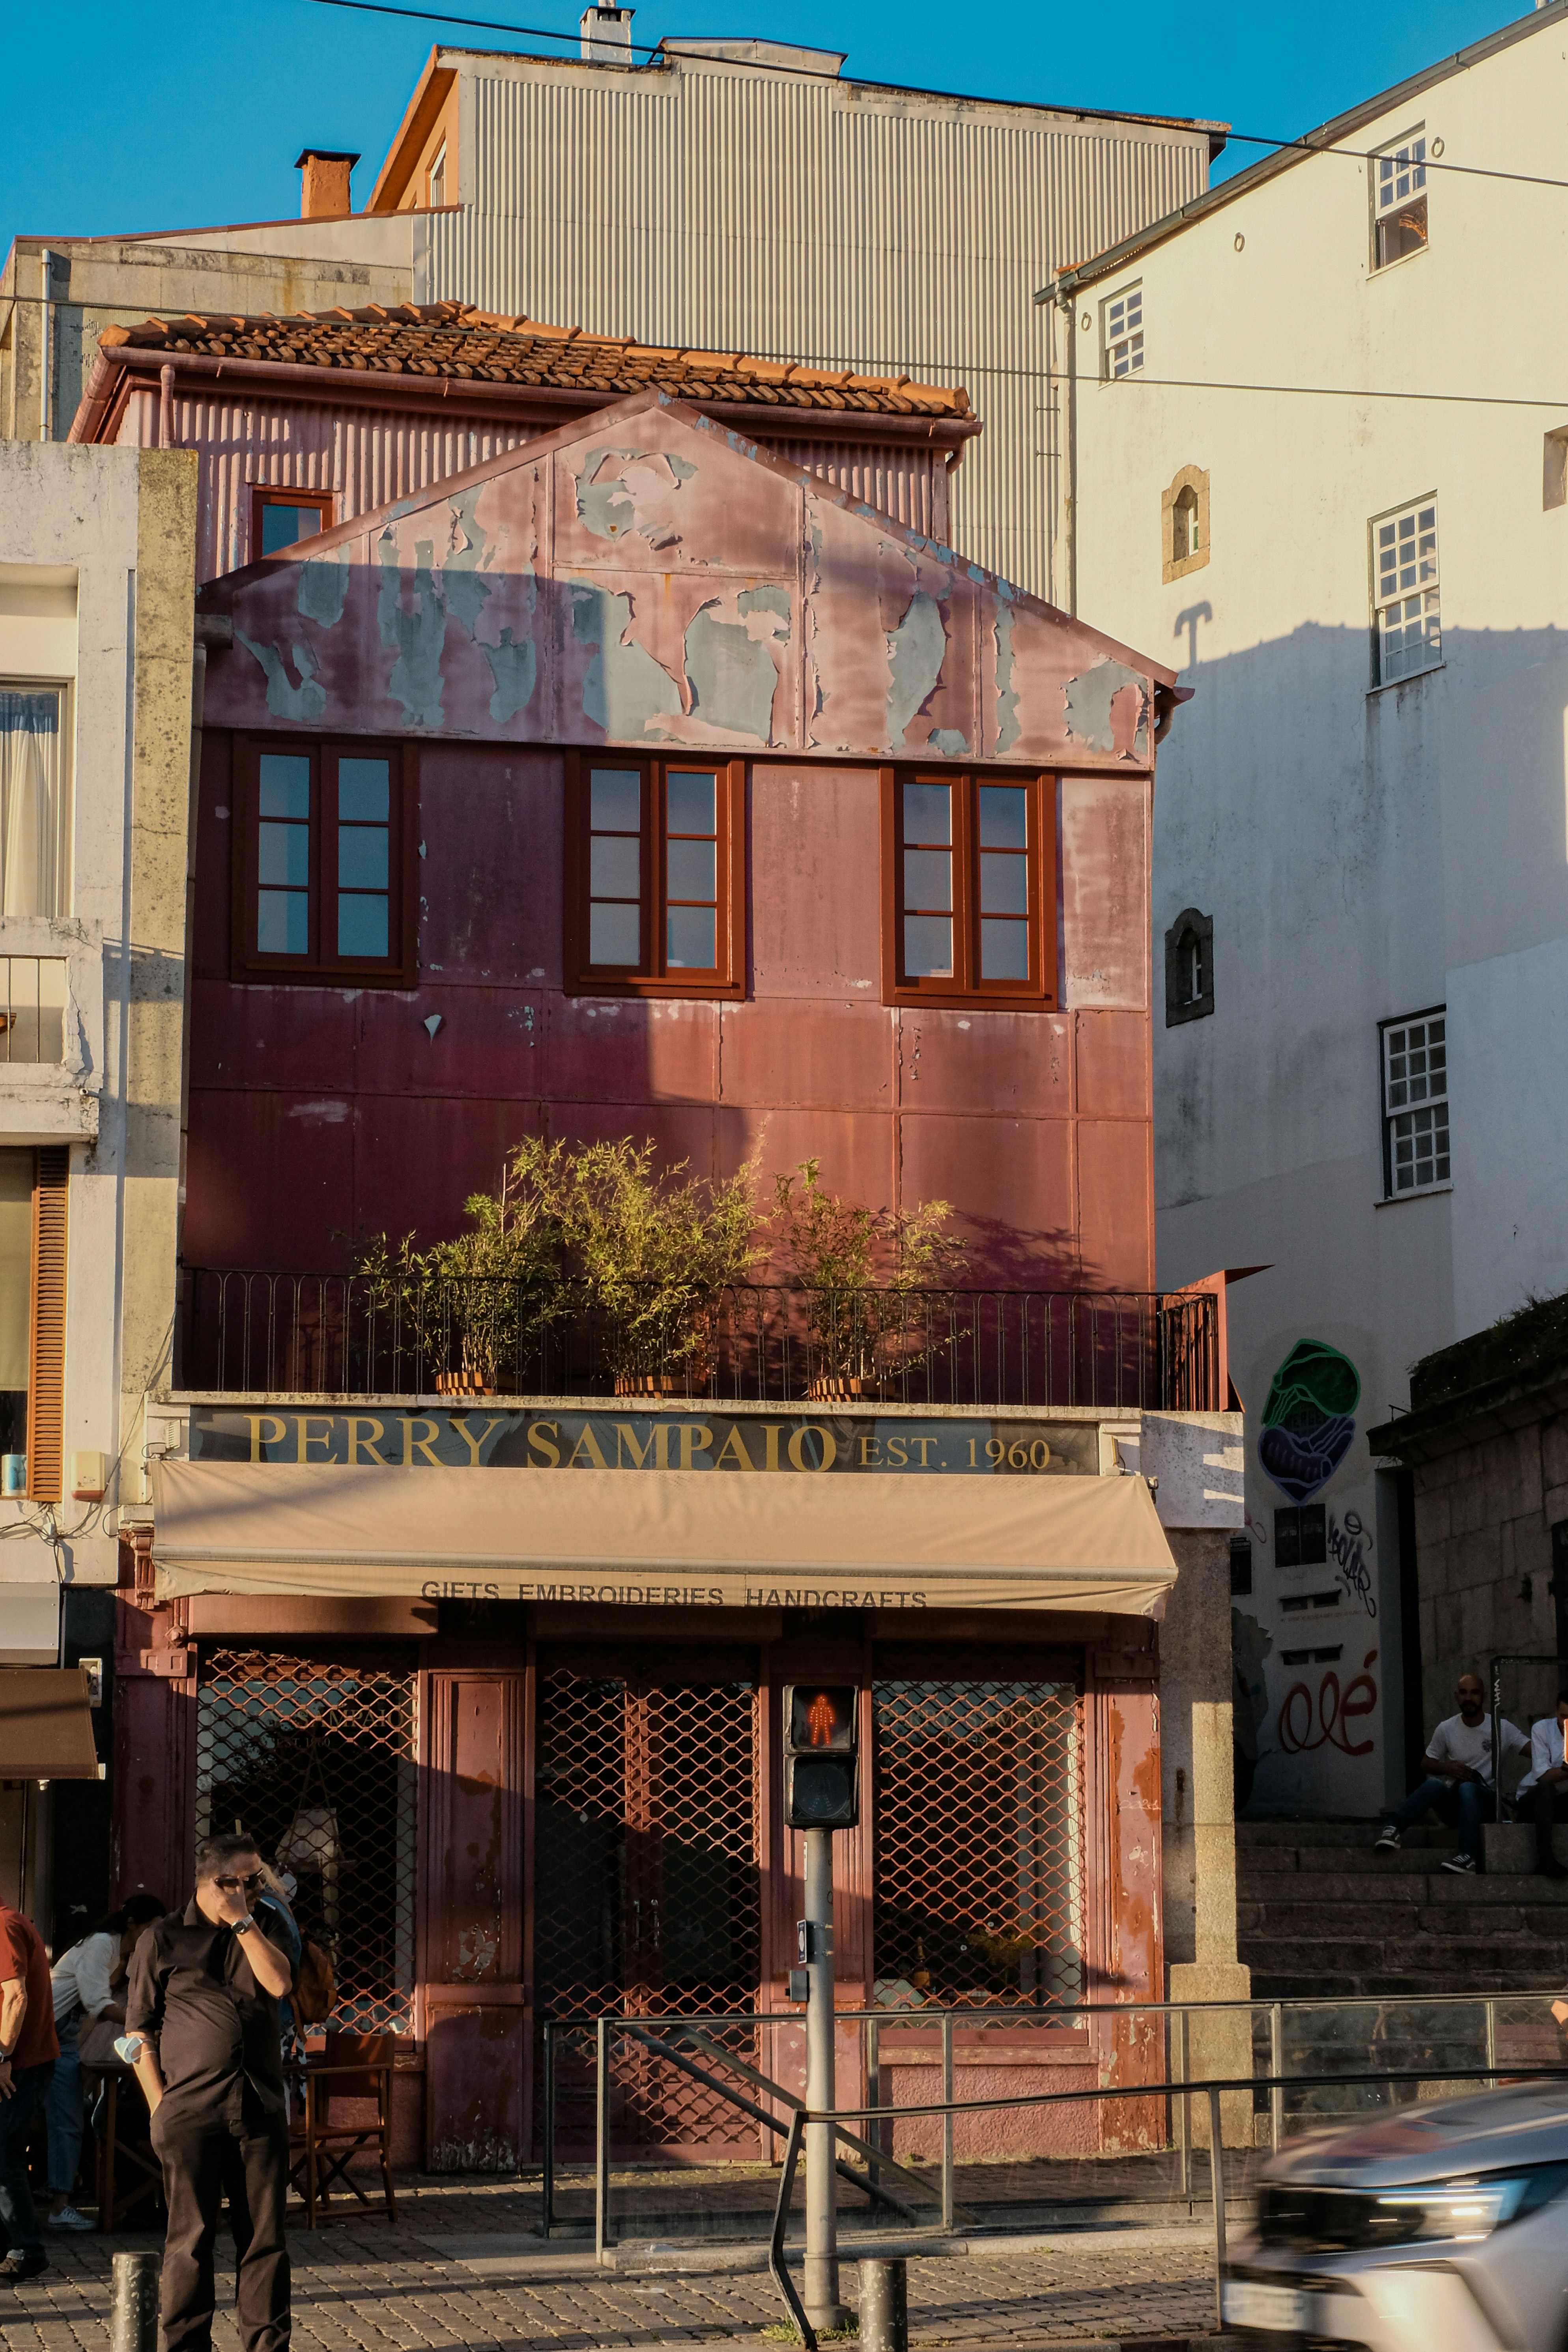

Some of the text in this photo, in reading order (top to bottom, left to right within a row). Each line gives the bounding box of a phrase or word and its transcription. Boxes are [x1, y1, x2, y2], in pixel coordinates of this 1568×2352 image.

[243, 1415, 1050, 1473] PERRY SAMPAIO EST. 1960
[421, 1580, 927, 1608] GIFTS EMBROIDERIES HANDCRAFTS
[305, 1737, 331, 1748] 160
